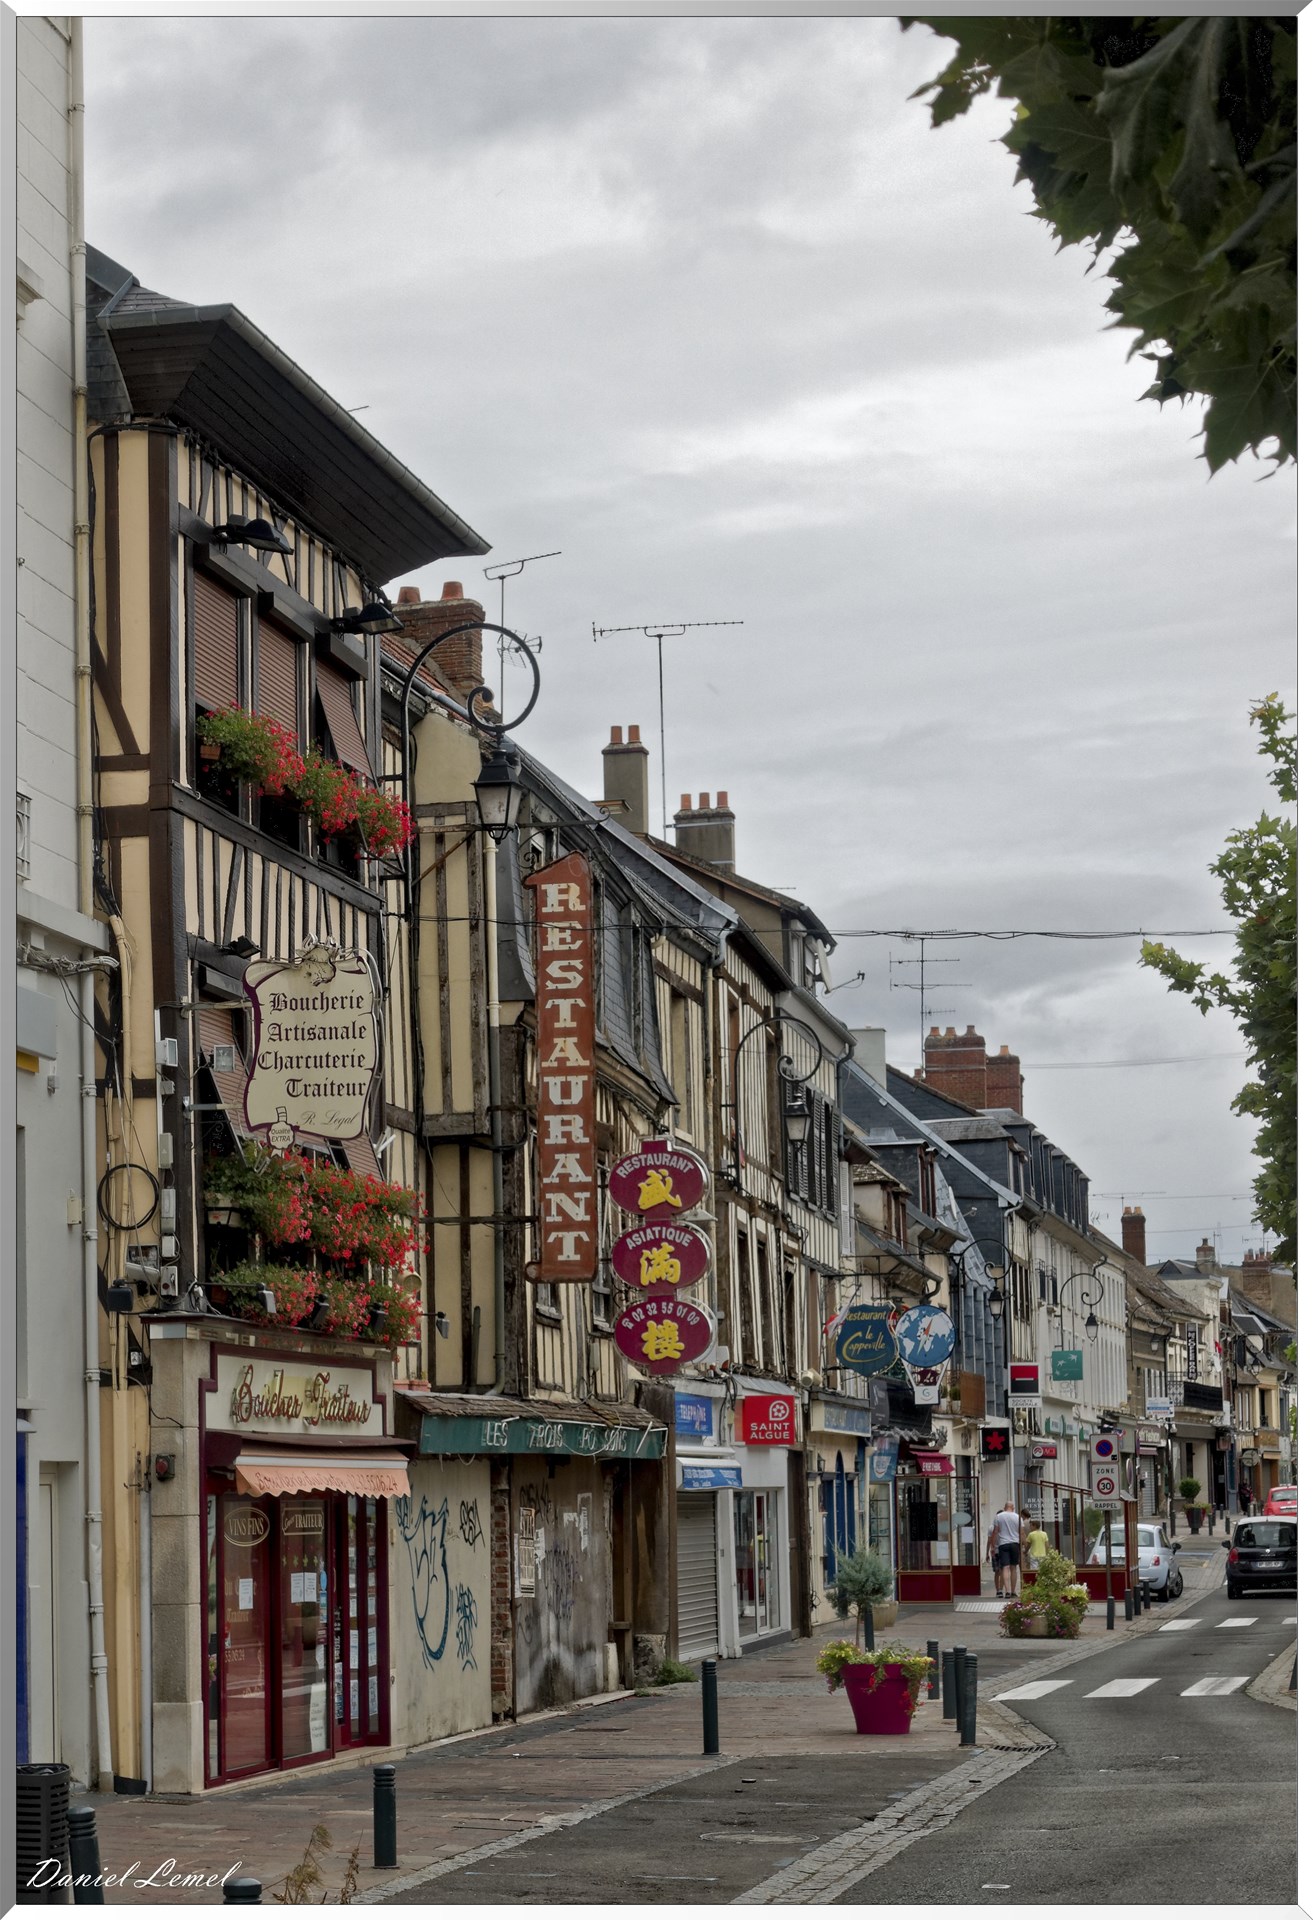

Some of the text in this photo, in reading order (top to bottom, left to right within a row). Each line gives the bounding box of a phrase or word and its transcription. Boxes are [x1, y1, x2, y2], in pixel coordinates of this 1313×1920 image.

[269, 990, 364, 1014] Boucherie
[267, 1020, 367, 1043] Artisanale
[258, 1049, 366, 1073] Charcuterie
[541, 883, 591, 1261] RESTAURANT
[285, 1078, 367, 1098] Traiteur
[321, 1110, 361, 1130] Legal
[271, 1135, 291, 1143] EXTRA
[616, 1153, 695, 1179] RESTAURANT
[626, 1226, 693, 1250] ASIATIQUE
[633, 1302, 701, 1326] 02 32 55 01 09
[311, 1372, 371, 1426] Traiteur
[486, 1421, 509, 1446] LES
[529, 1423, 564, 1448] TROIS
[750, 1422, 790, 1432] SAINT
[750, 1431, 790, 1440] ALGUE
[1101, 1482, 1112, 1491] 30
[229, 1519, 247, 1536] VINS
[247, 1518, 264, 1536] FINS
[295, 1514, 323, 1529] TRAITEUR
